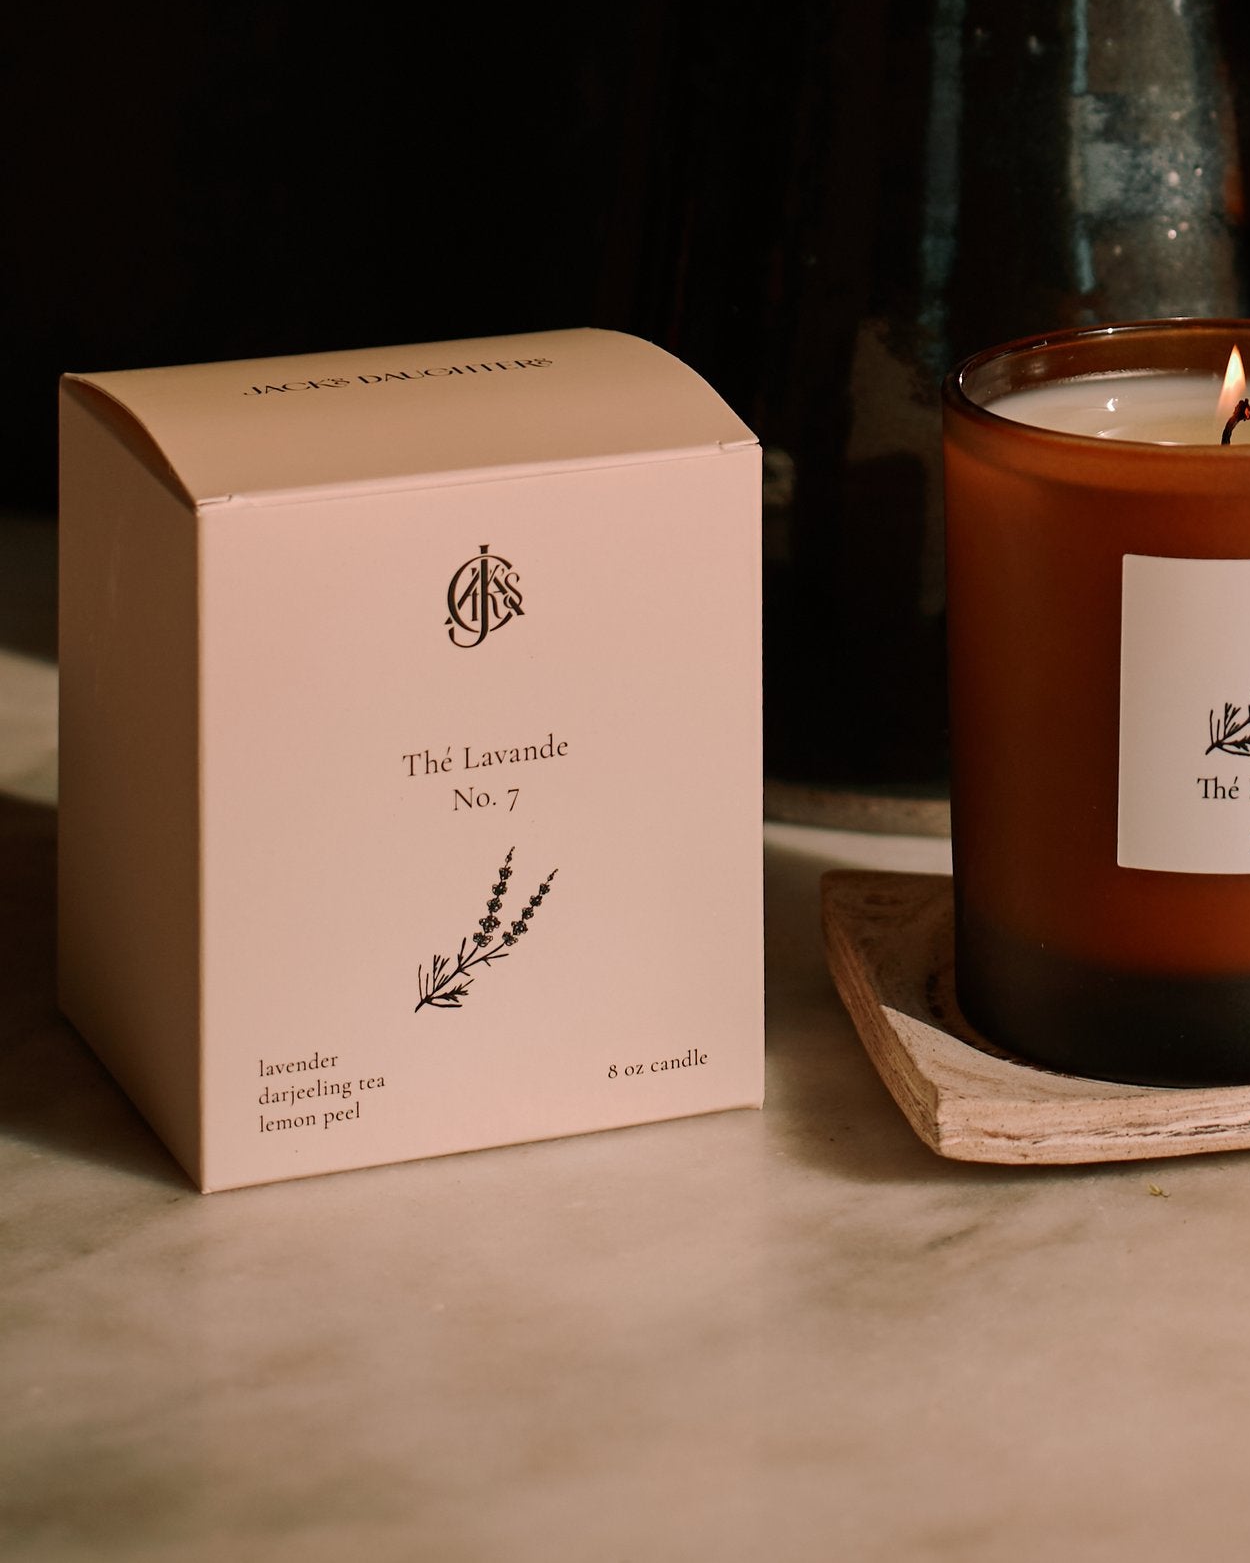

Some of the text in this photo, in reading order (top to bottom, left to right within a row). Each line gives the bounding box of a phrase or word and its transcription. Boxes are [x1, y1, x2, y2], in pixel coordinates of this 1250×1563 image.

[243, 357, 554, 396] JACK'S DAUGHTERS
[402, 733, 570, 777] Thé Lavande
[452, 787, 520, 812] No. 7
[1197, 776, 1239, 799] Thé
[259, 1052, 339, 1077] lavender
[607, 1048, 709, 1079] 8 oz candle
[258, 1074, 386, 1106] darjeeling tea
[259, 1102, 361, 1133] lemon peel
